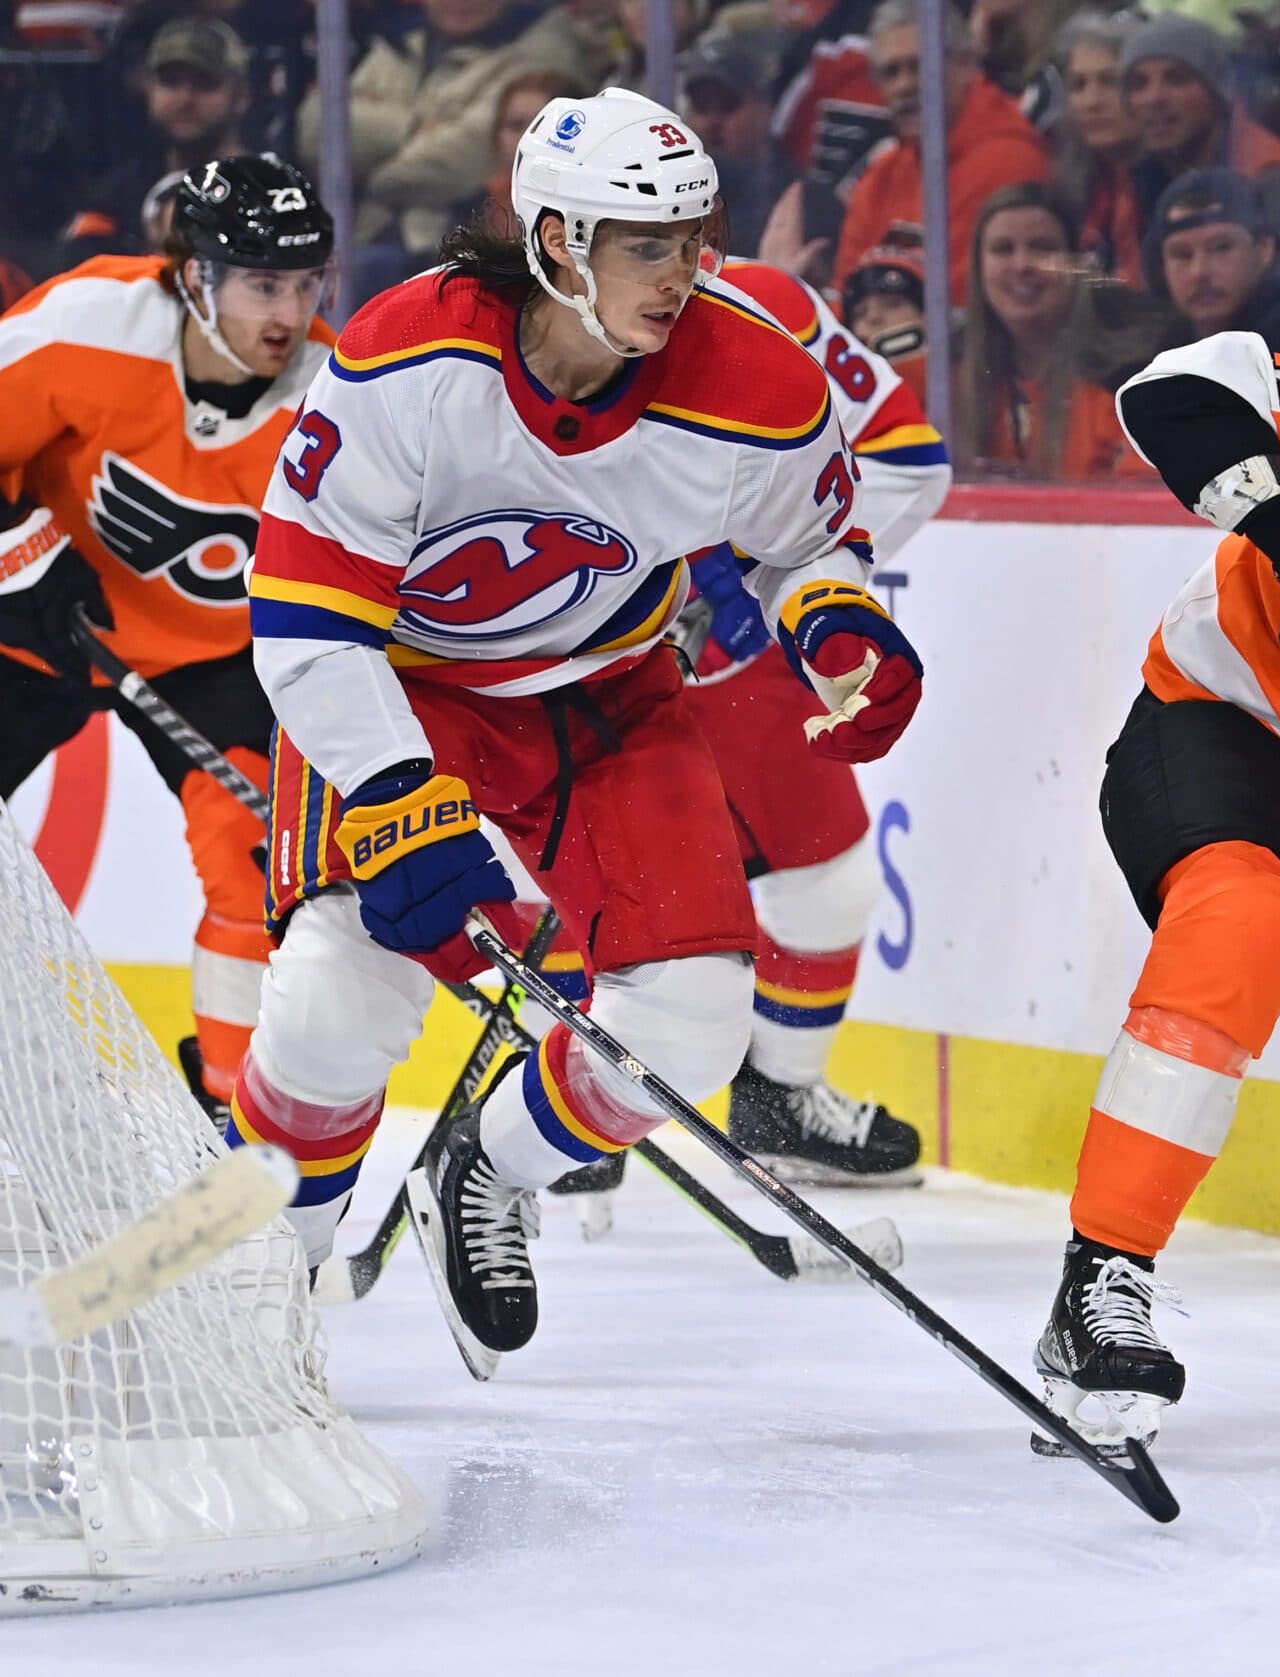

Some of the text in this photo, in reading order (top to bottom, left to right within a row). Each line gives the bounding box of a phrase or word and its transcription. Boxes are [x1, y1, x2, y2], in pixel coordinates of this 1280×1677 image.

[546, 138, 576, 154] Prudential
[649, 123, 688, 148] 33
[674, 178, 709, 193] CCM
[266, 187, 307, 214] 23
[281, 398, 342, 503] 3
[813, 440, 862, 535] 3
[281, 829, 290, 886] CCM
